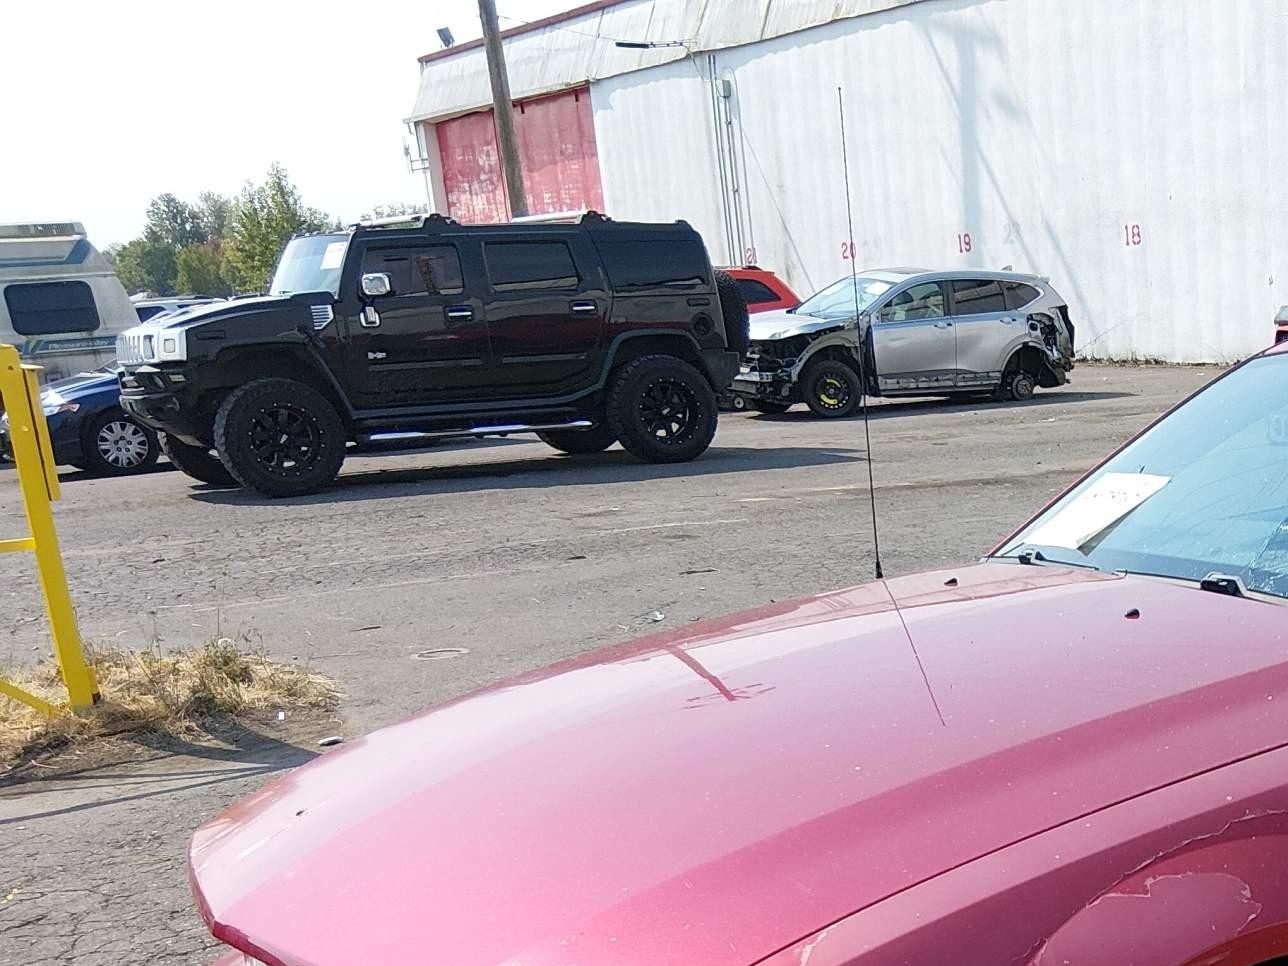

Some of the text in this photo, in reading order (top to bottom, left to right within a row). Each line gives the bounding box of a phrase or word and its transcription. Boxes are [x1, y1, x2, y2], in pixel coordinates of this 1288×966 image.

[957, 233, 972, 254] 19
[1124, 224, 1142, 246] 18
[841, 242, 857, 260] 20
